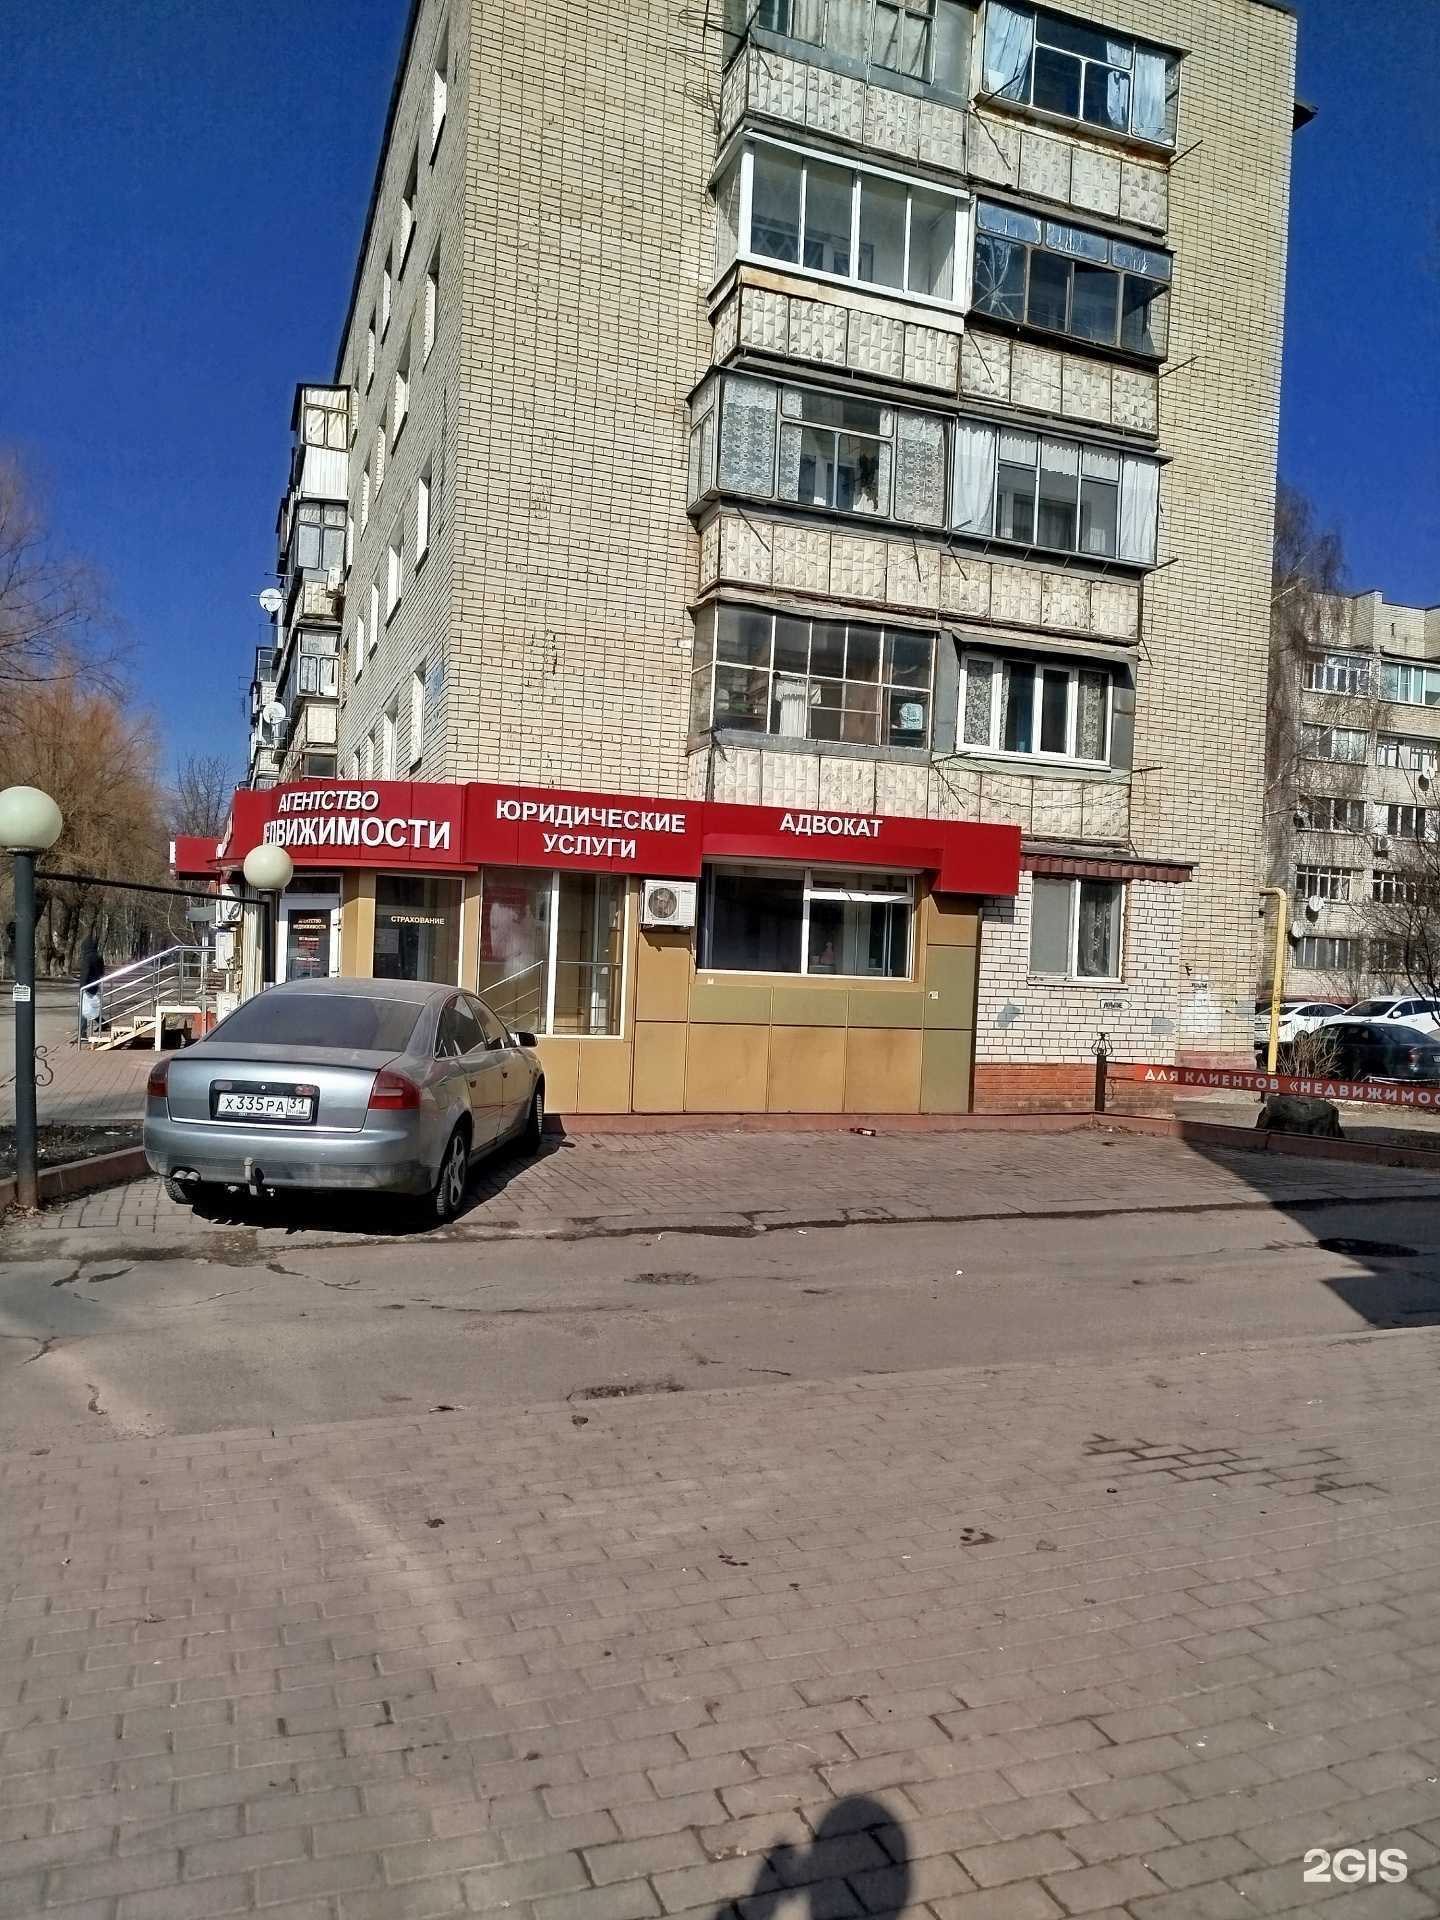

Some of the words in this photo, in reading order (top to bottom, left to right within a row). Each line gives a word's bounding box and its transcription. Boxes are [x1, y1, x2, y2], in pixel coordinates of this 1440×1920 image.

[278, 790, 379, 813] АГЕНТСТВО
[496, 799, 686, 833] ЮРИДИЧЕСКИЕ
[779, 813, 883, 837] АДВОКАТ
[542, 833, 636, 858] УСЛУГИ
[390, 915, 445, 925] СТРАХОВАНИЕ
[1144, 1068, 1179, 1081] ДЛЯ
[1185, 1071, 1279, 1090] КЛИЕНТОВ
